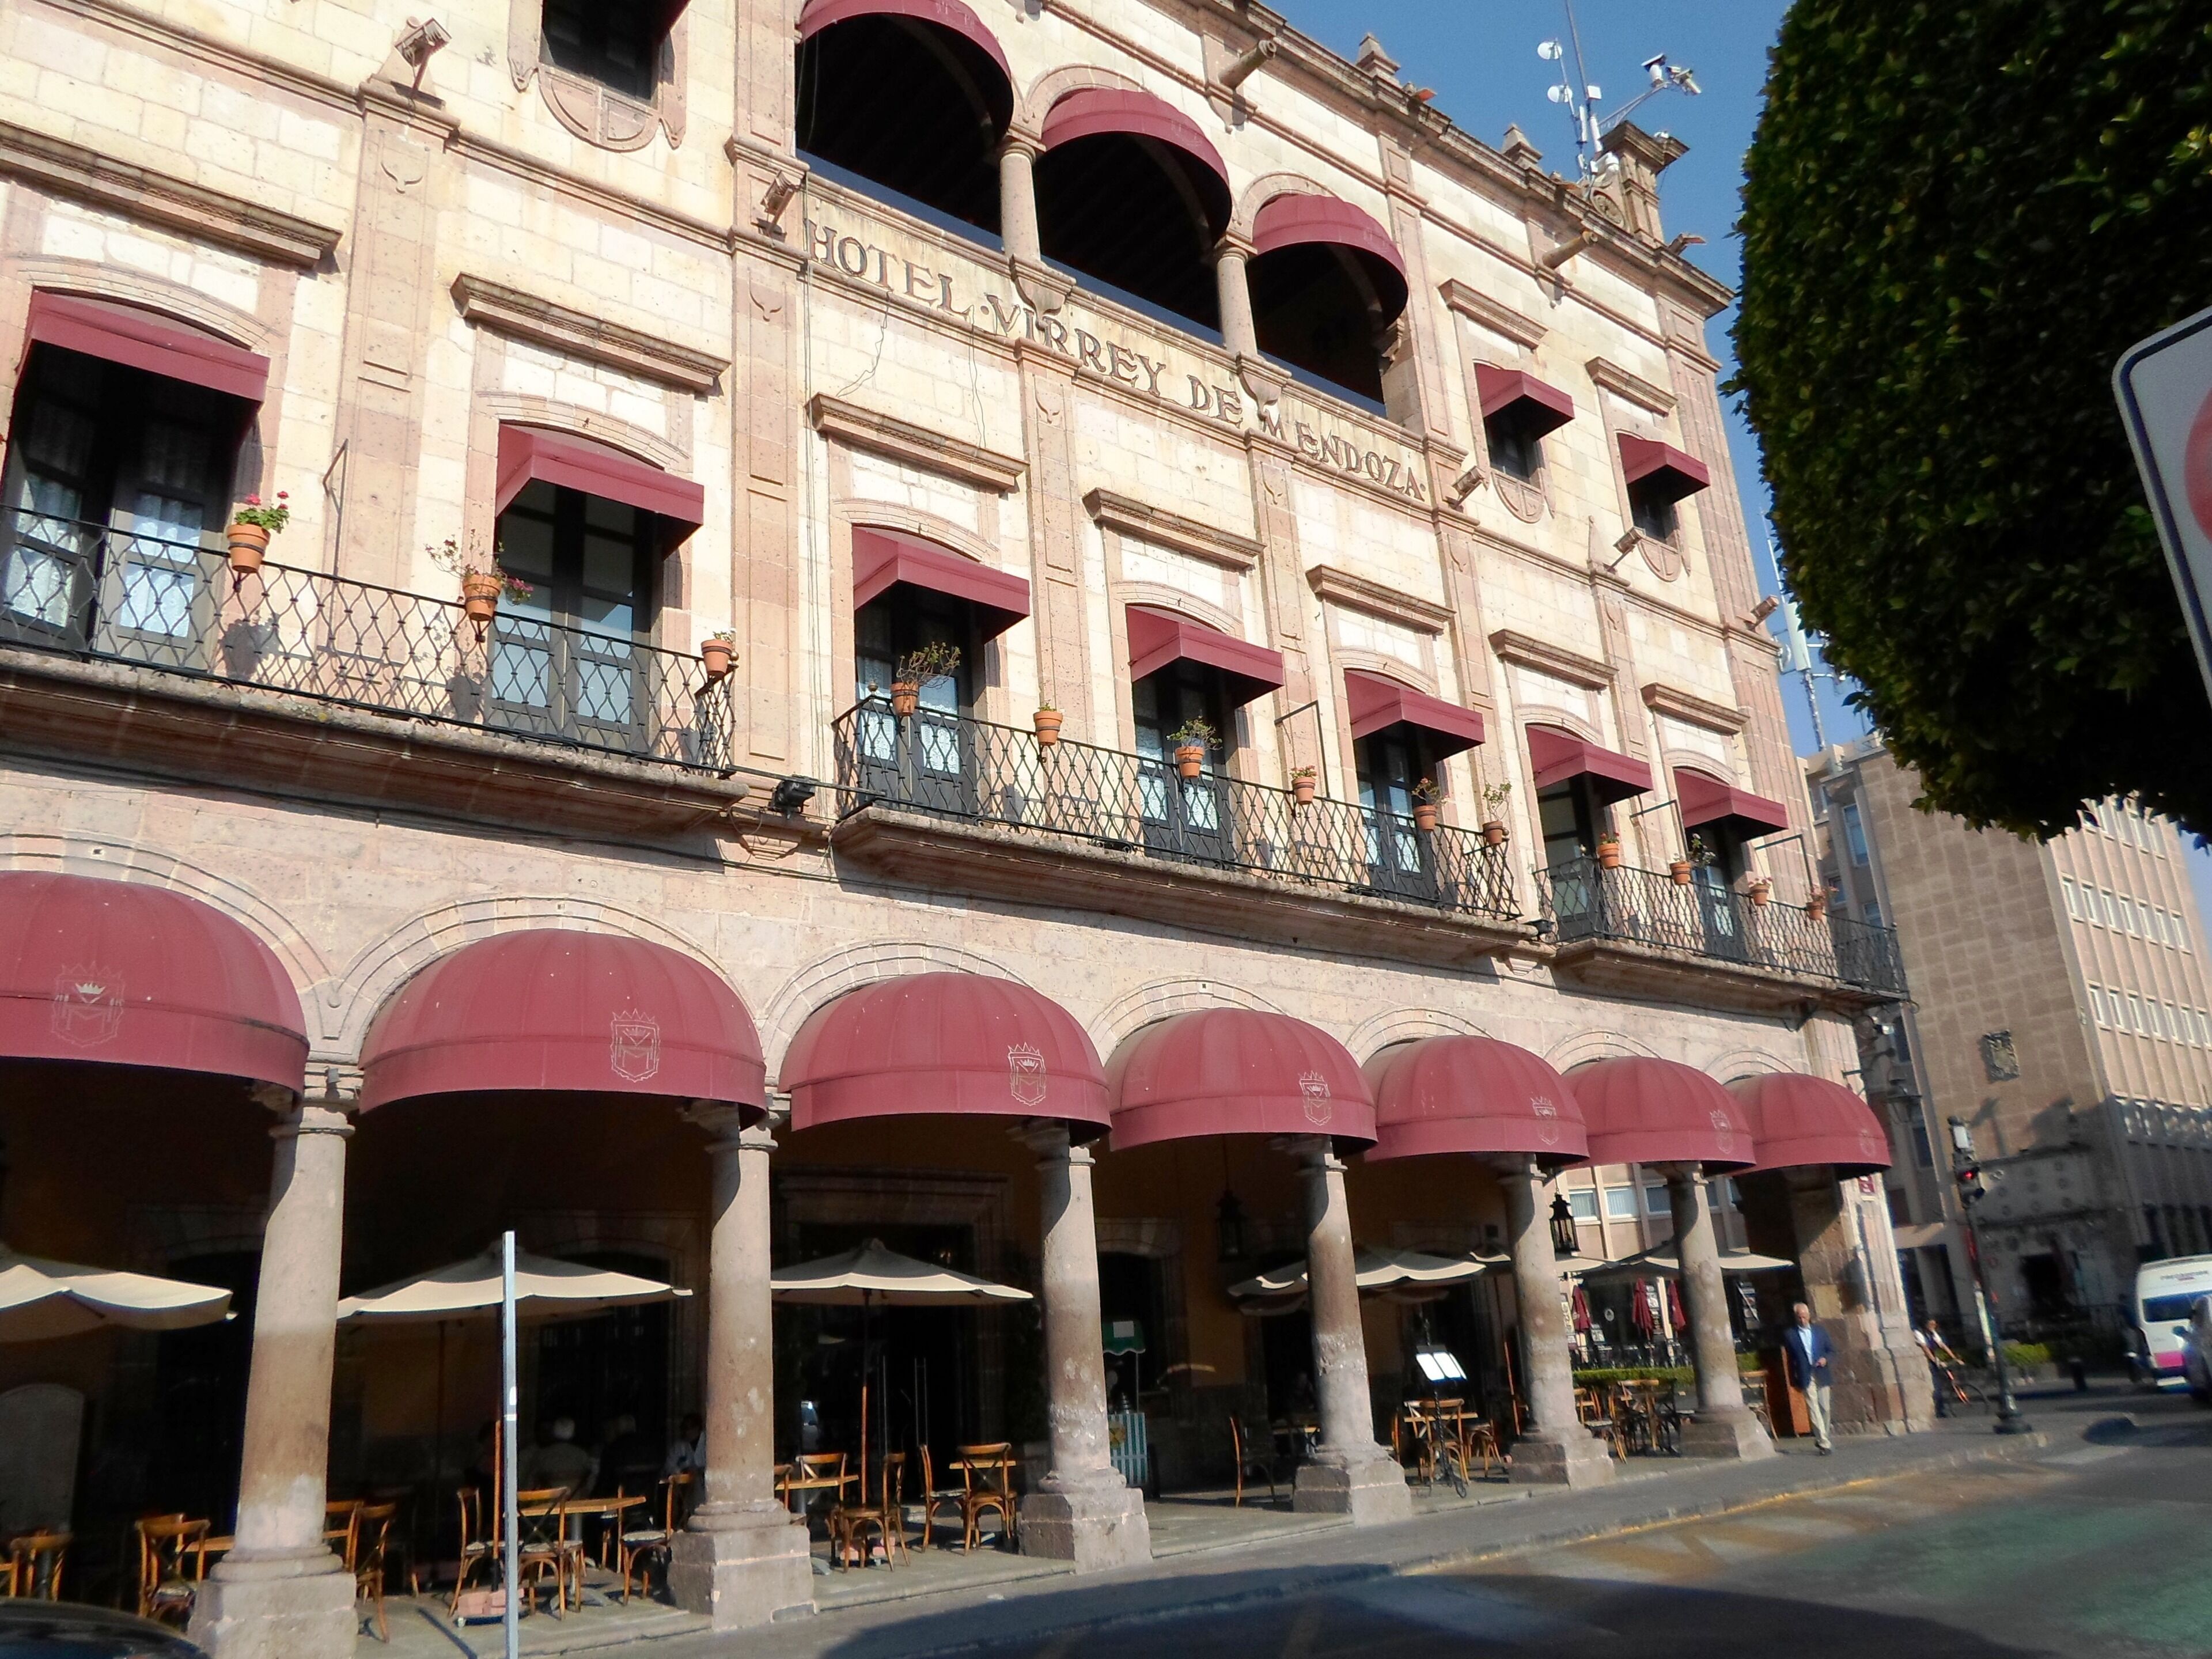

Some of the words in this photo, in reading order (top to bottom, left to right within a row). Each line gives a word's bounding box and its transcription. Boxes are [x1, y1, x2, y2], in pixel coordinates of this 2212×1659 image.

[805, 219, 974, 320] HOTEL
[984, 292, 1166, 397] VIRREY
[1187, 374, 1243, 429] DE
